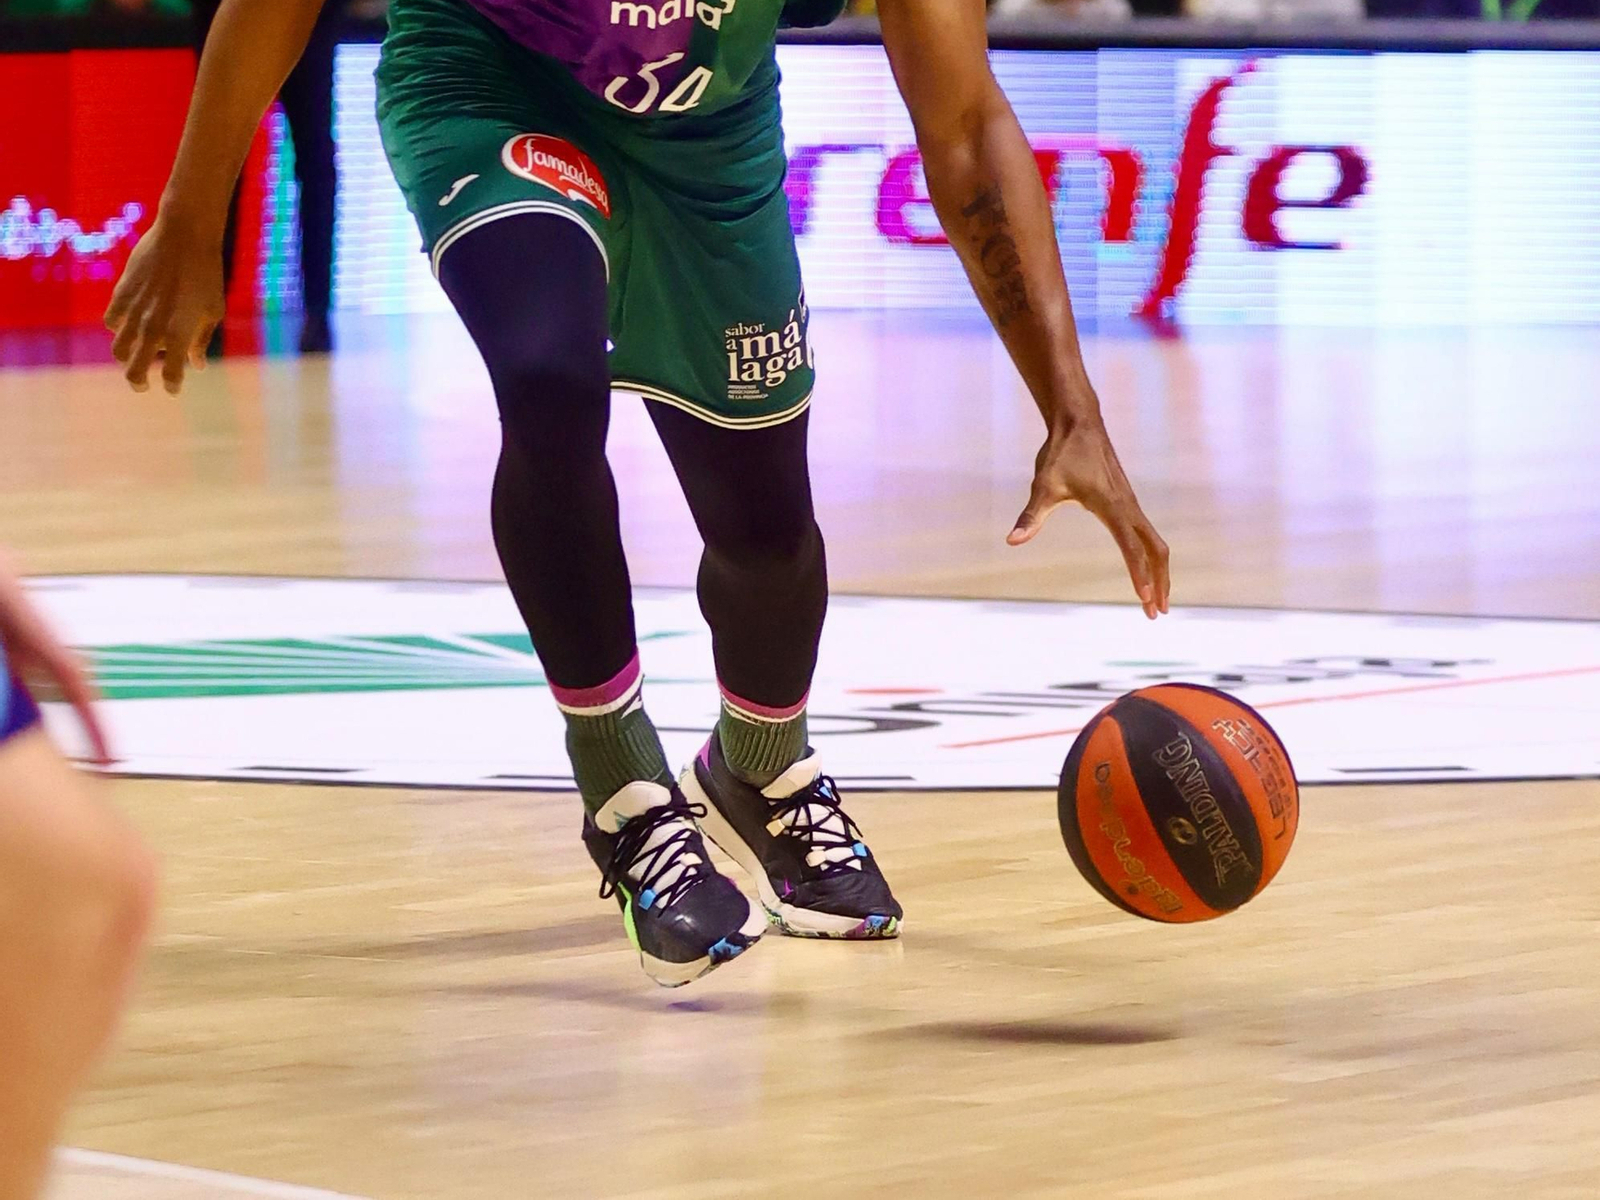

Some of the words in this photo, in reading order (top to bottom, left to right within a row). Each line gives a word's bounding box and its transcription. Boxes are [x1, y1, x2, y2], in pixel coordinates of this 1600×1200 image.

[523, 138, 610, 213] famadesa
[725, 322, 765, 338] sabor
[726, 338, 738, 350] a
[739, 309, 802, 359] má
[727, 346, 804, 388] laga
[1151, 731, 1254, 888] PALDING
